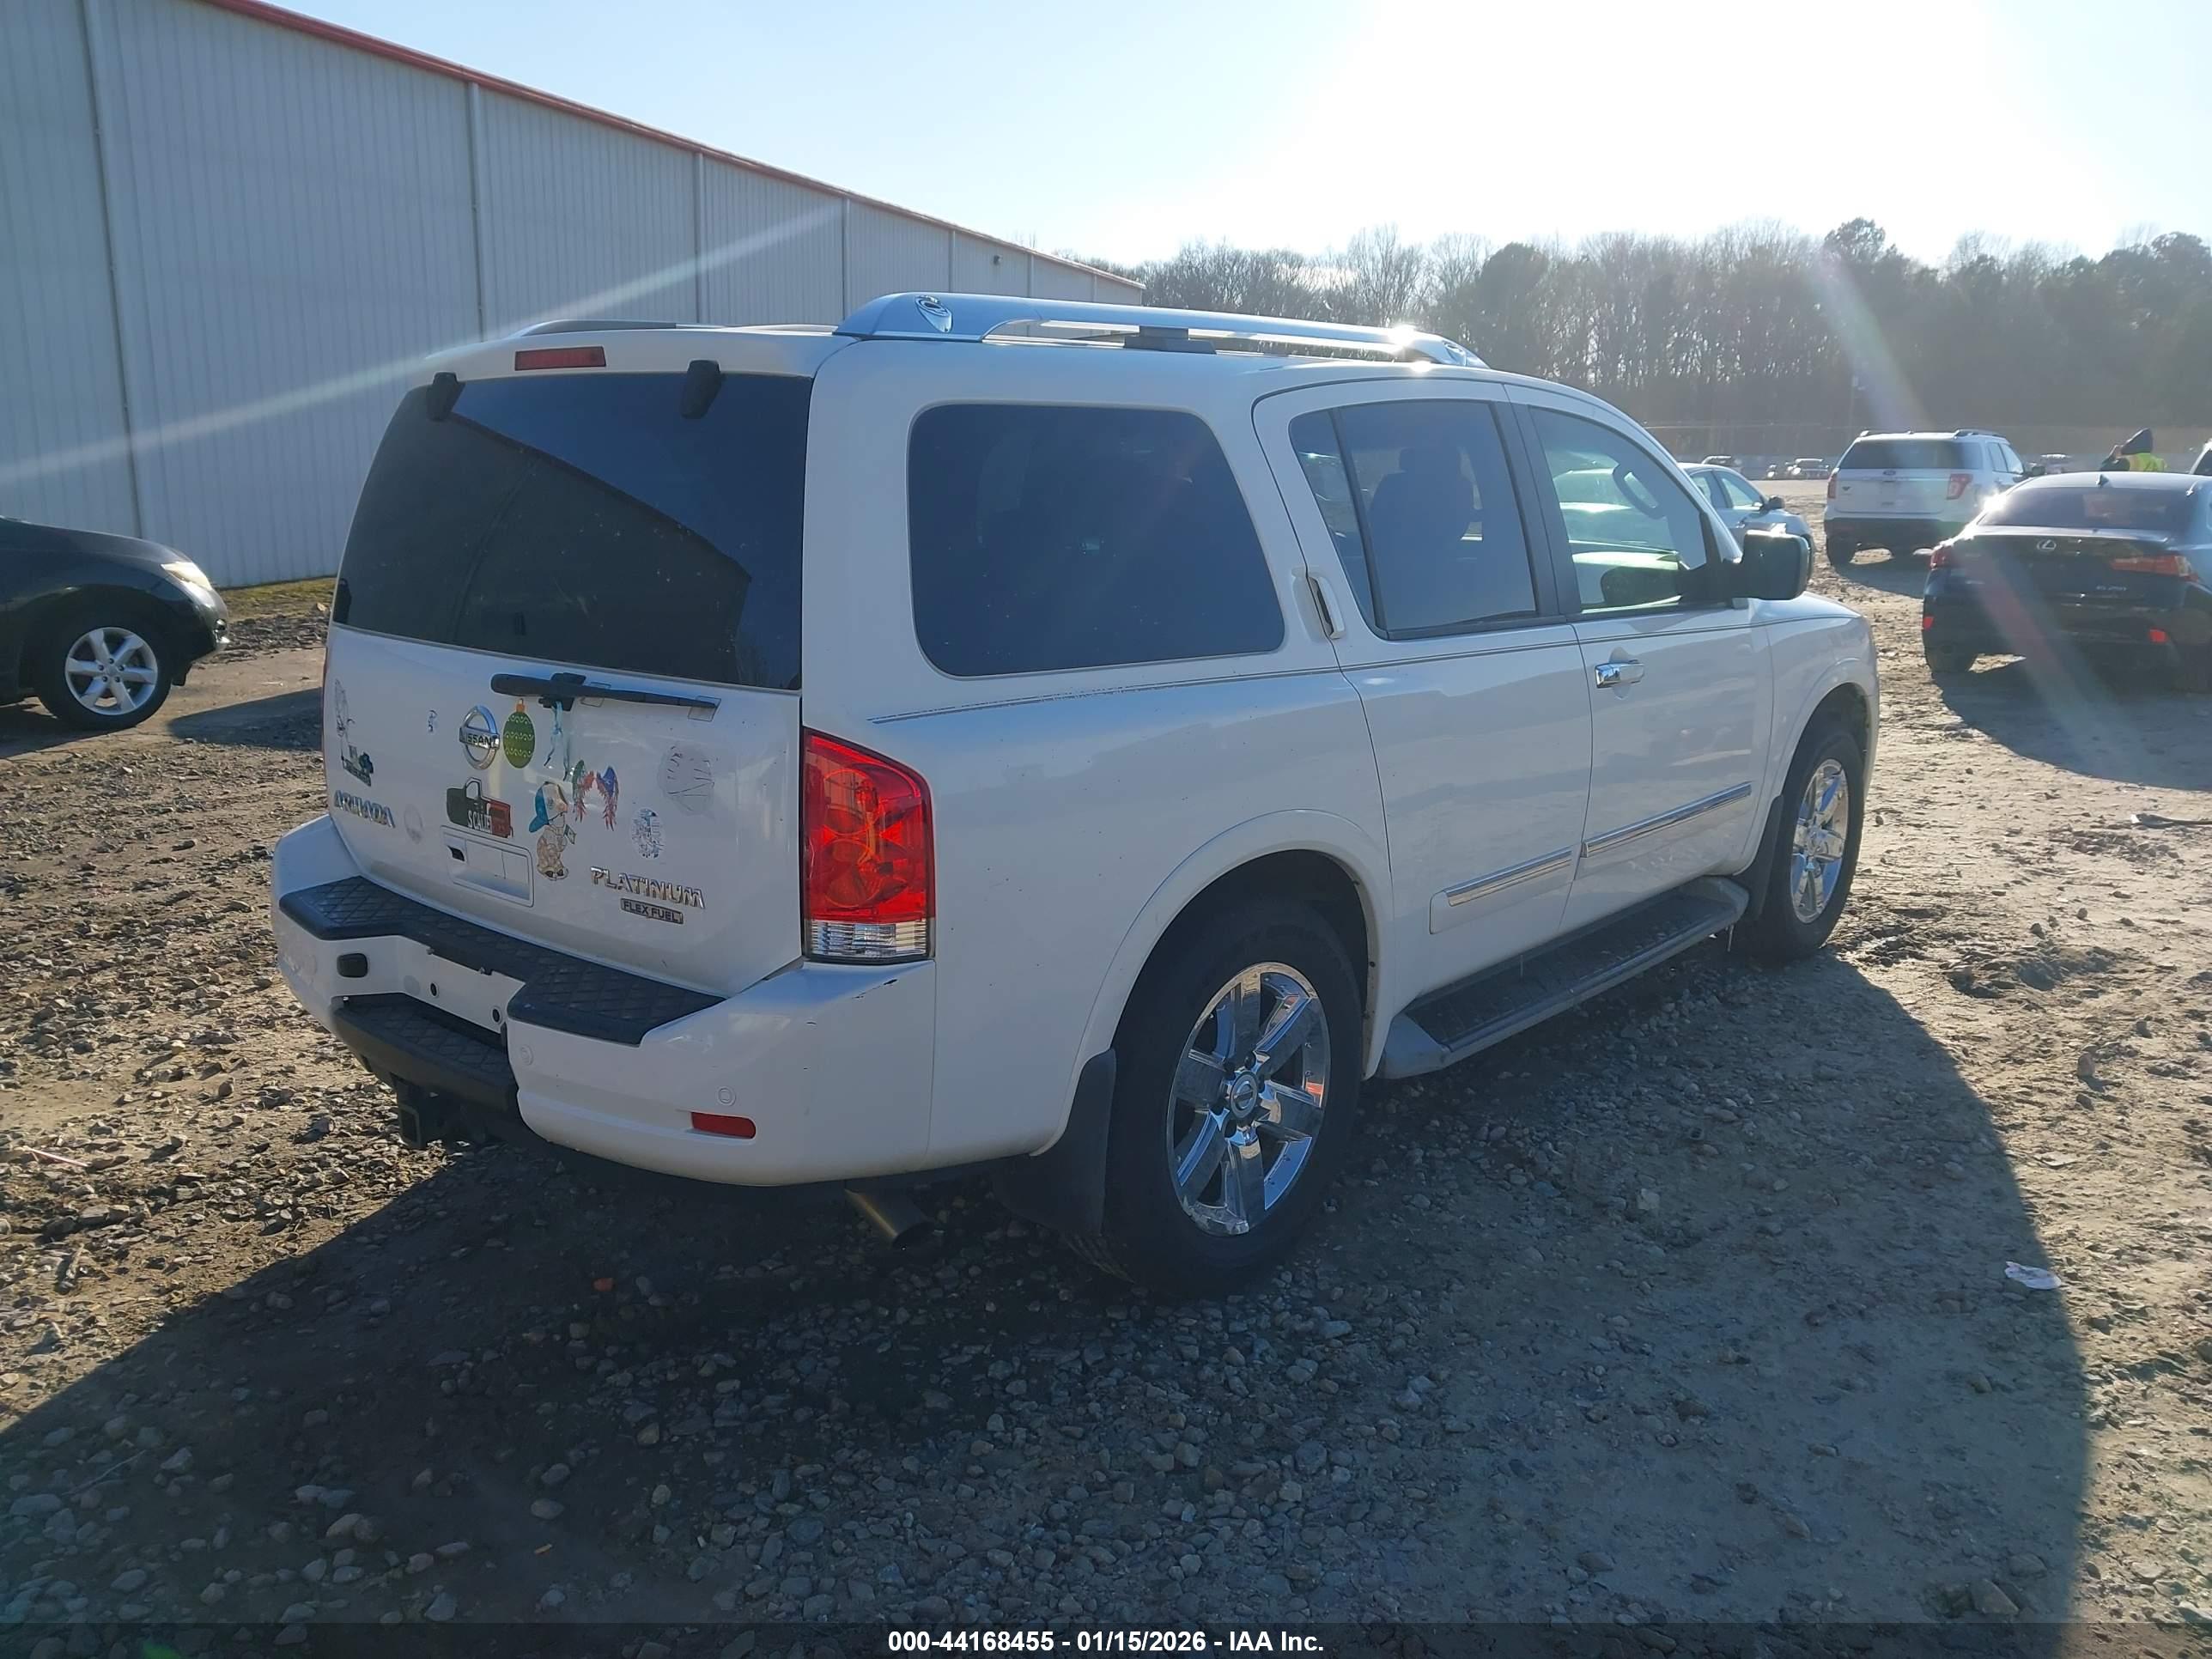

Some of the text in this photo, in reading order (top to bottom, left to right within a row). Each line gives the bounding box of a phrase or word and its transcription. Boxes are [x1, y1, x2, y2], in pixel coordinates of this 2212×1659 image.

[461, 729, 492, 746] NISSAN
[333, 789, 396, 829] ARMADA
[590, 866, 706, 909] PLATINUM
[623, 900, 679, 922] FLEX FUEL
